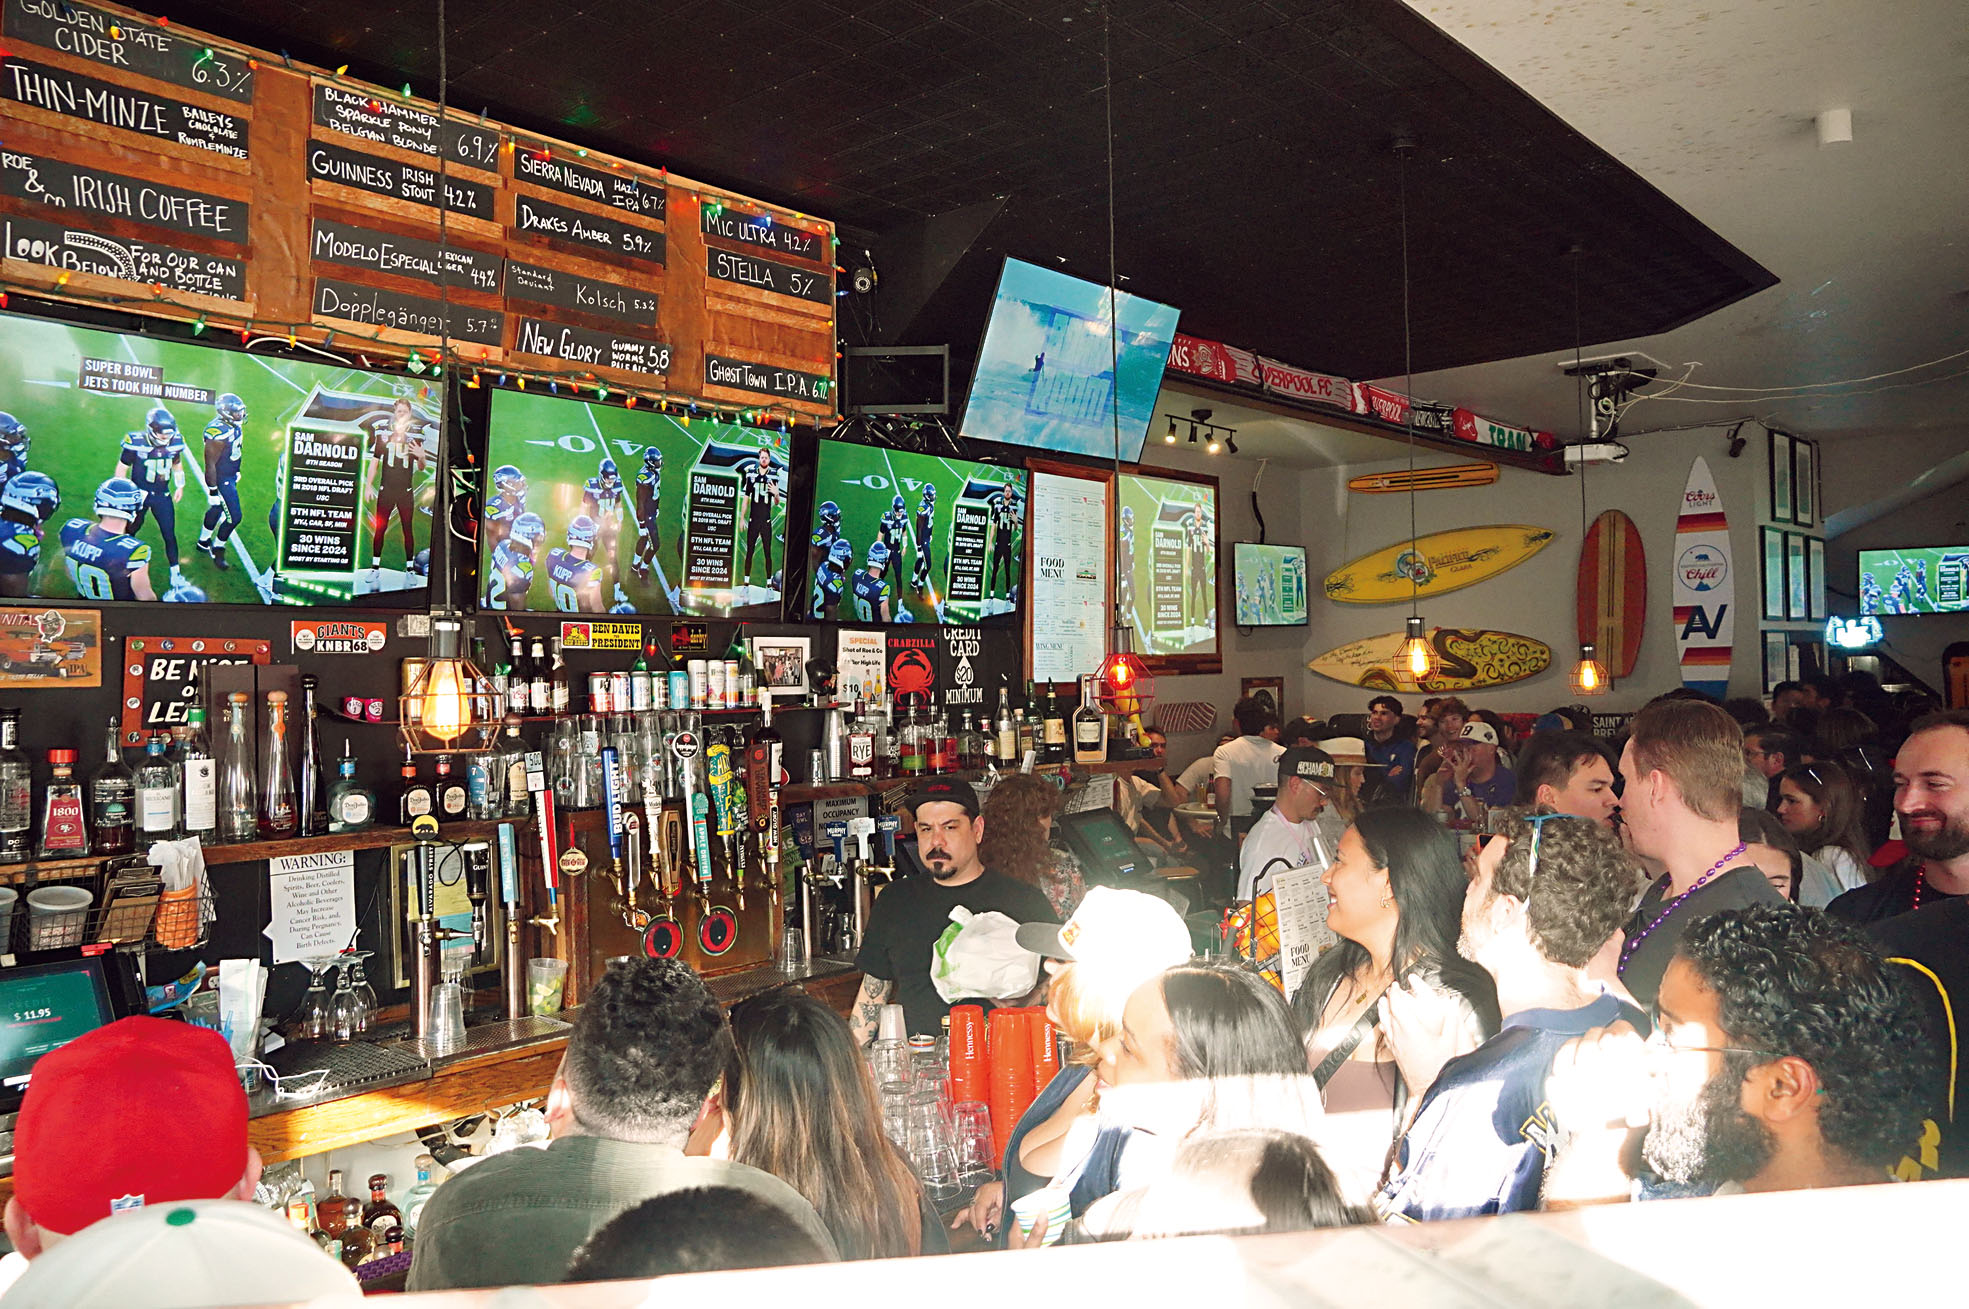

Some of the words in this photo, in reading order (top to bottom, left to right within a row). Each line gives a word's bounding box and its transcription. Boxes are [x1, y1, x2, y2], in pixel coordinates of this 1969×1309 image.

[20, 2, 104, 33] GOLDEN
[117, 25, 172, 52] STATE
[55, 28, 129, 65] CIDER
[192, 57, 251, 93] 6.3%
[5, 64, 169, 134] THIN-MINZE
[325, 87, 370, 108] BLACK
[379, 101, 441, 127] HAMMER
[182, 106, 234, 128] BAILEYS
[336, 105, 391, 128] SPARKLE
[398, 122, 433, 140] PONY
[330, 118, 385, 143] BELGIAN
[392, 134, 437, 154] BLONDE
[457, 134, 499, 163] 6.9%
[1, 152, 32, 170] ROE
[312, 151, 393, 190] GUINNESS
[402, 167, 435, 186] IRISH
[520, 153, 563, 186] SIERRA
[563, 167, 605, 198] NEVADA
[401, 183, 435, 200] STOUT
[444, 184, 477, 209] 4.2%
[73, 175, 132, 216] IRISH
[140, 189, 232, 232] COFFEE
[612, 196, 639, 212] IPA
[520, 204, 568, 233] DRAKES
[571, 220, 612, 245] AMBER
[622, 233, 652, 254] 5.9%
[706, 211, 733, 237] MIC
[739, 221, 776, 247] ULTRA
[784, 232, 811, 252] 4.2%
[5, 221, 59, 268] LOOK
[316, 229, 379, 262] MODELO
[380, 243, 438, 275] ESPECIAL
[130, 245, 161, 266] FOR
[167, 253, 199, 271] OUR
[207, 261, 237, 278] CAN
[139, 261, 170, 279] AND
[174, 266, 222, 290] BOTTLE
[717, 253, 774, 288] STELLA
[789, 274, 814, 296] 5%
[577, 284, 626, 313] Kolsch
[522, 322, 553, 357] NEW
[560, 328, 602, 364] GLORY
[611, 339, 646, 353] GUMMY
[612, 352, 645, 365] WORMS
[647, 345, 670, 369] 5.8
[84, 358, 122, 375] SUPER
[124, 363, 158, 380] BOWL.
[710, 358, 743, 385] GHOST
[744, 370, 768, 388] TOWN
[83, 374, 109, 390] JETS
[111, 378, 140, 394] TOOK
[142, 382, 163, 396] HIM
[164, 384, 208, 401] NUMBER
[295, 432, 315, 442] SAM
[294, 441, 358, 459] DARNOLD
[694, 476, 707, 484] SAM
[693, 483, 735, 498] DARNOLD
[1686, 490, 1715, 502] Coors
[1689, 500, 1712, 508] LIGHT
[310, 509, 327, 518] NFL
[328, 510, 352, 519] TEAM
[300, 534, 313, 544] 30
[314, 535, 341, 546] WINS
[71, 539, 103, 561] KUPP
[291, 543, 320, 554] SINCE
[322, 546, 348, 555] 2024
[691, 566, 711, 574] SINCE
[711, 567, 728, 575] 2024
[706, 559, 723, 567] WINS
[1041, 556, 1064, 569] FOOD
[552, 564, 572, 581] KUPP
[1041, 569, 1064, 579] MENU
[1686, 568, 1718, 580] Chill
[317, 623, 365, 639] GIANTS
[592, 624, 610, 634] BEN
[612, 625, 640, 635] DAVIS
[316, 640, 352, 652] KNBR
[353, 641, 368, 651] 68
[592, 638, 640, 648] PRESIDENT
[849, 637, 878, 645] SPECIAL
[888, 638, 935, 648] CRABZILLA
[950, 640, 980, 657] CARD
[69, 664, 86, 674] IPA
[150, 658, 185, 680] BE
[954, 665, 972, 680] $20
[946, 687, 983, 704] MINIMUM
[1593, 716, 1621, 728] SAINT
[851, 743, 872, 758] RYE
[610, 758, 621, 800] LIGHT
[53, 806, 78, 817] 1800
[825, 798, 857, 808] MAXIMUM
[612, 802, 622, 835] BUD
[822, 808, 860, 819] OCCUPANCY
[827, 827, 846, 835] MURPHY
[877, 820, 898, 829] MURPHY
[699, 827, 707, 849] APPLE
[280, 852, 346, 870] WARNING:
[702, 850, 710, 875] DRIVEN
[288, 874, 314, 882] Drinking
[316, 870, 340, 879] Distilled
[1290, 943, 1309, 957] FOOD
[1292, 955, 1310, 967] MENU
[24, 1007, 51, 1020] 11.95
[965, 1021, 974, 1059] Hennessy
[1043, 1022, 1052, 1062] Hennessy
